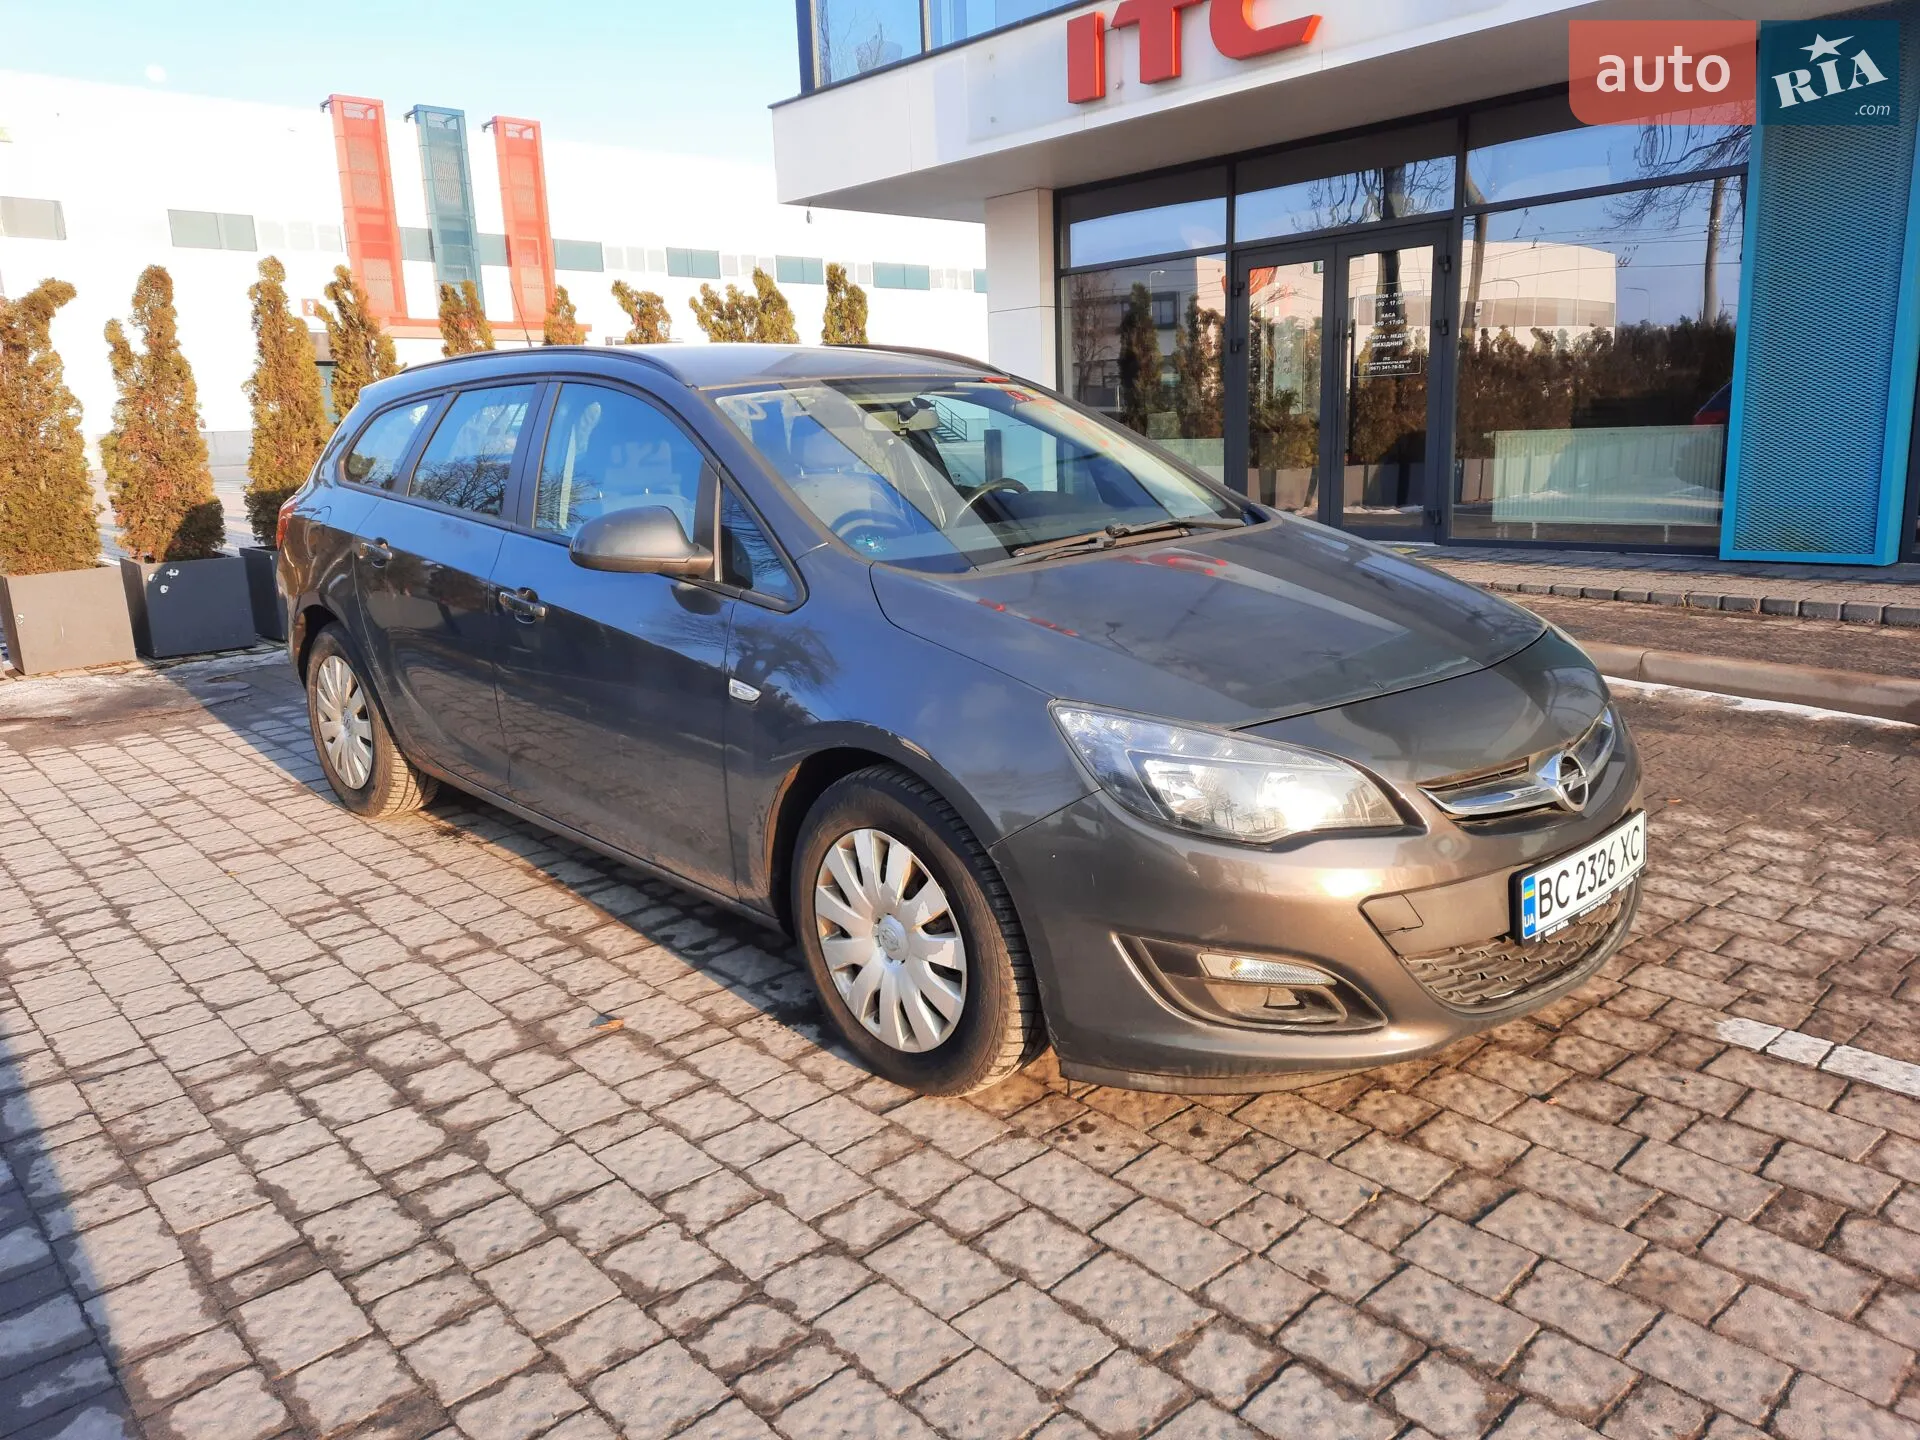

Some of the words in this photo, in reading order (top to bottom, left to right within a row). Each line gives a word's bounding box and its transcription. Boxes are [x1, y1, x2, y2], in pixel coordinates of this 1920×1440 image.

[1538, 869, 1570, 920] BC
[1576, 840, 1616, 902] 2326
[1620, 825, 1640, 873] XC
[1524, 915, 1535, 928] UA
